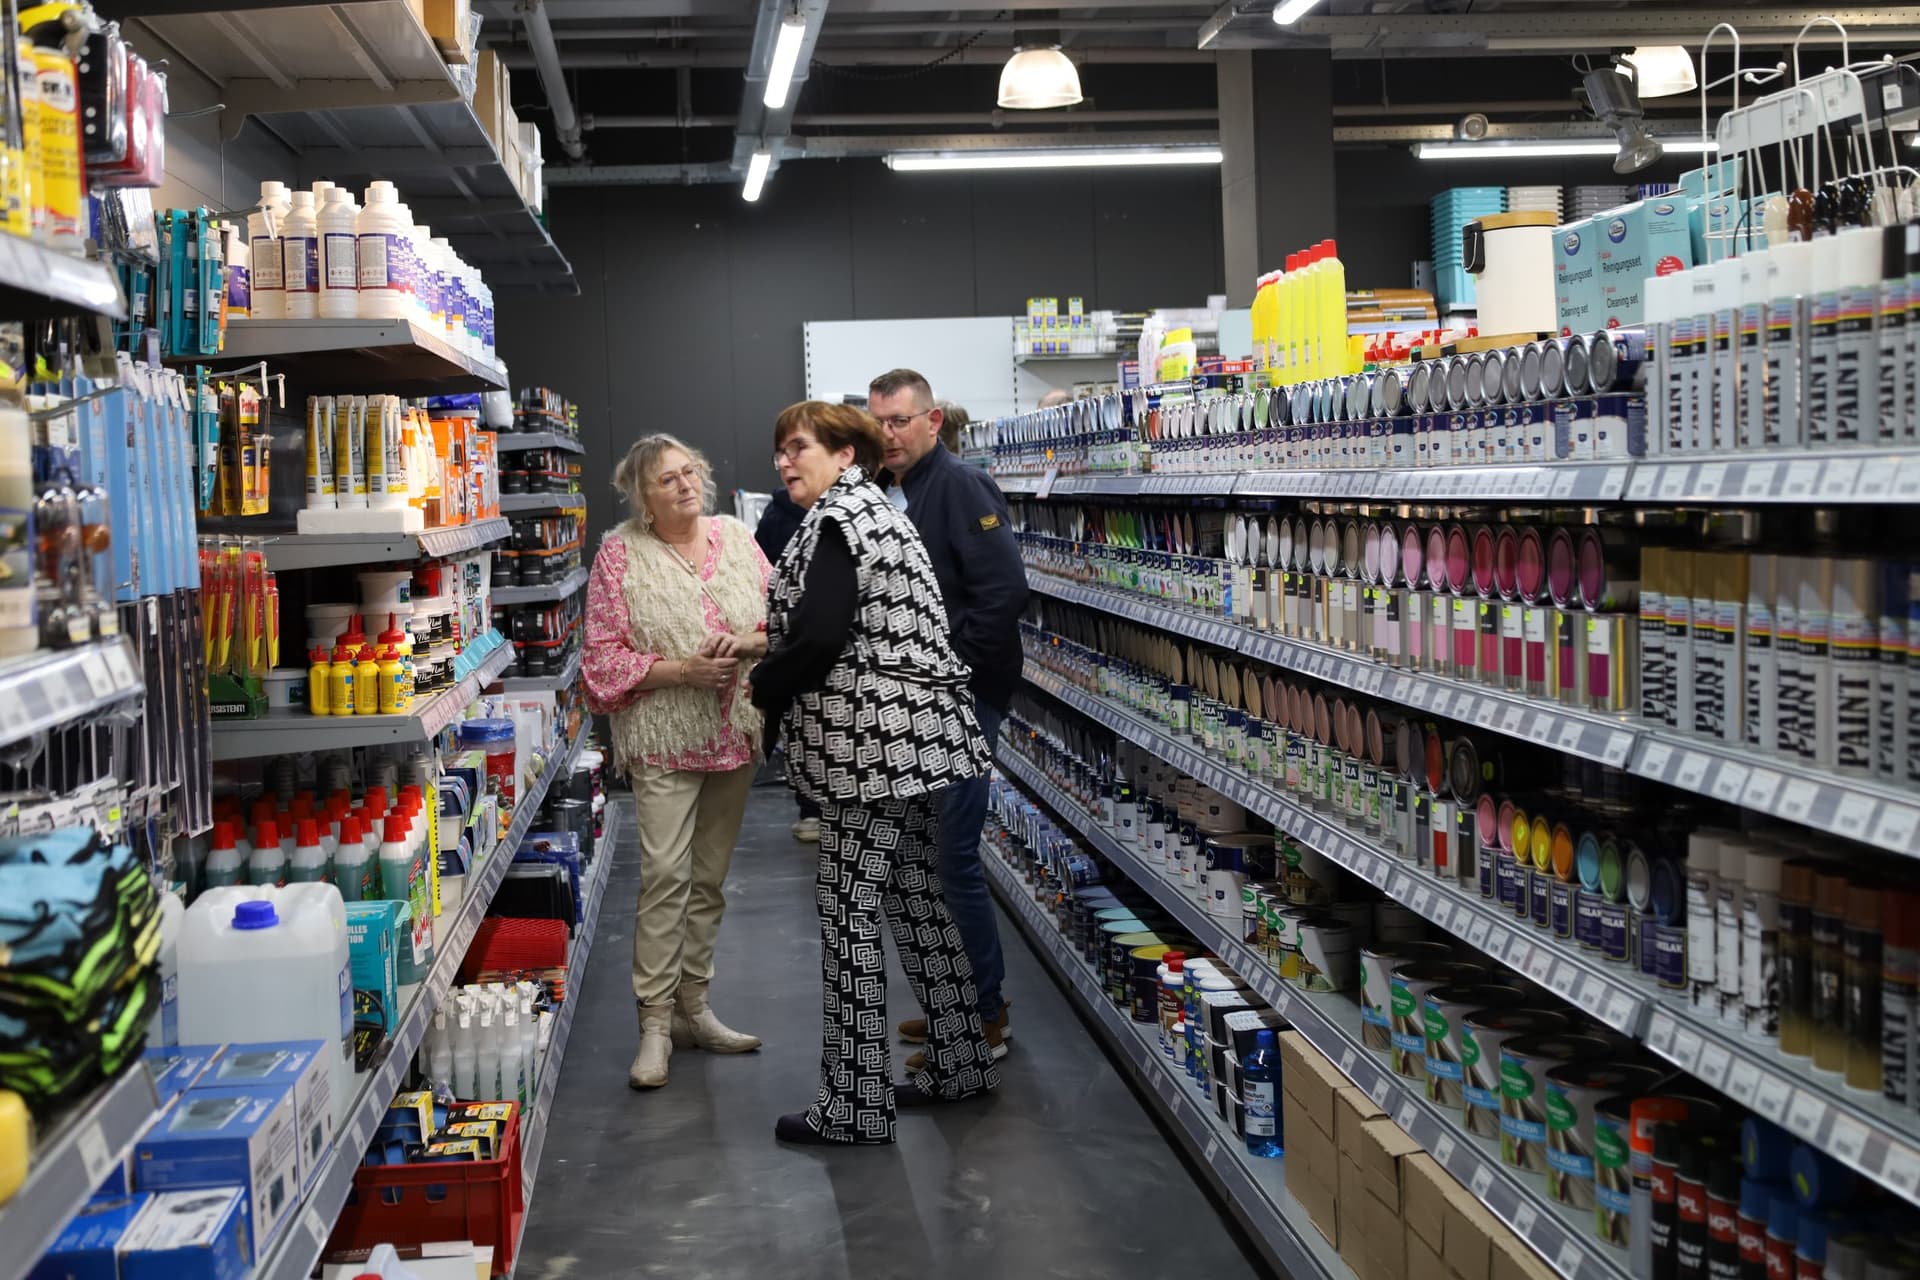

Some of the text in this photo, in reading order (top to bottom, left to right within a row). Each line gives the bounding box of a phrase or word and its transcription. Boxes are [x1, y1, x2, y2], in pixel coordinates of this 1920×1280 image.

[1602, 255, 1642, 274] Reinigungsset
[1606, 296, 1630, 309] Cleaning
[208, 704, 246, 713] RSISTENT!
[1838, 673, 1870, 769] PAINT
